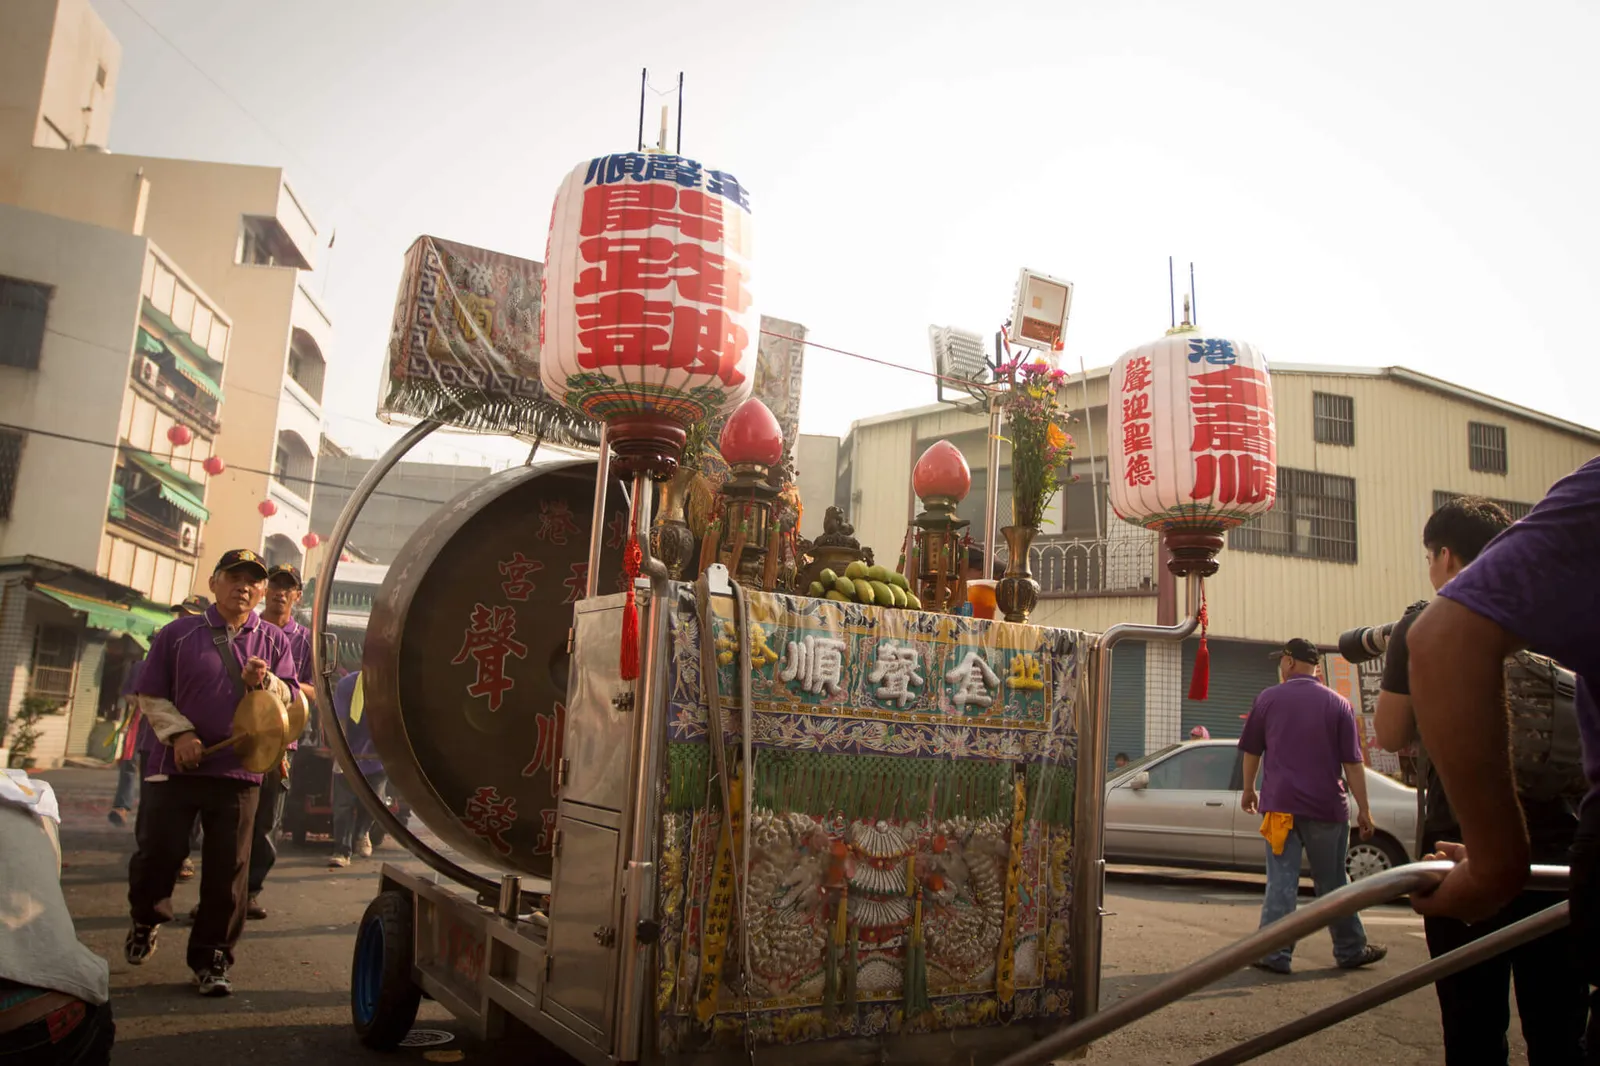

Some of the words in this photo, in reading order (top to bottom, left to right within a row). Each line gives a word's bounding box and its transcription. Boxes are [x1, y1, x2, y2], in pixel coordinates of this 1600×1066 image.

[1187, 338, 1238, 365] 港
[1121, 356, 1157, 487] 聲迎聖德
